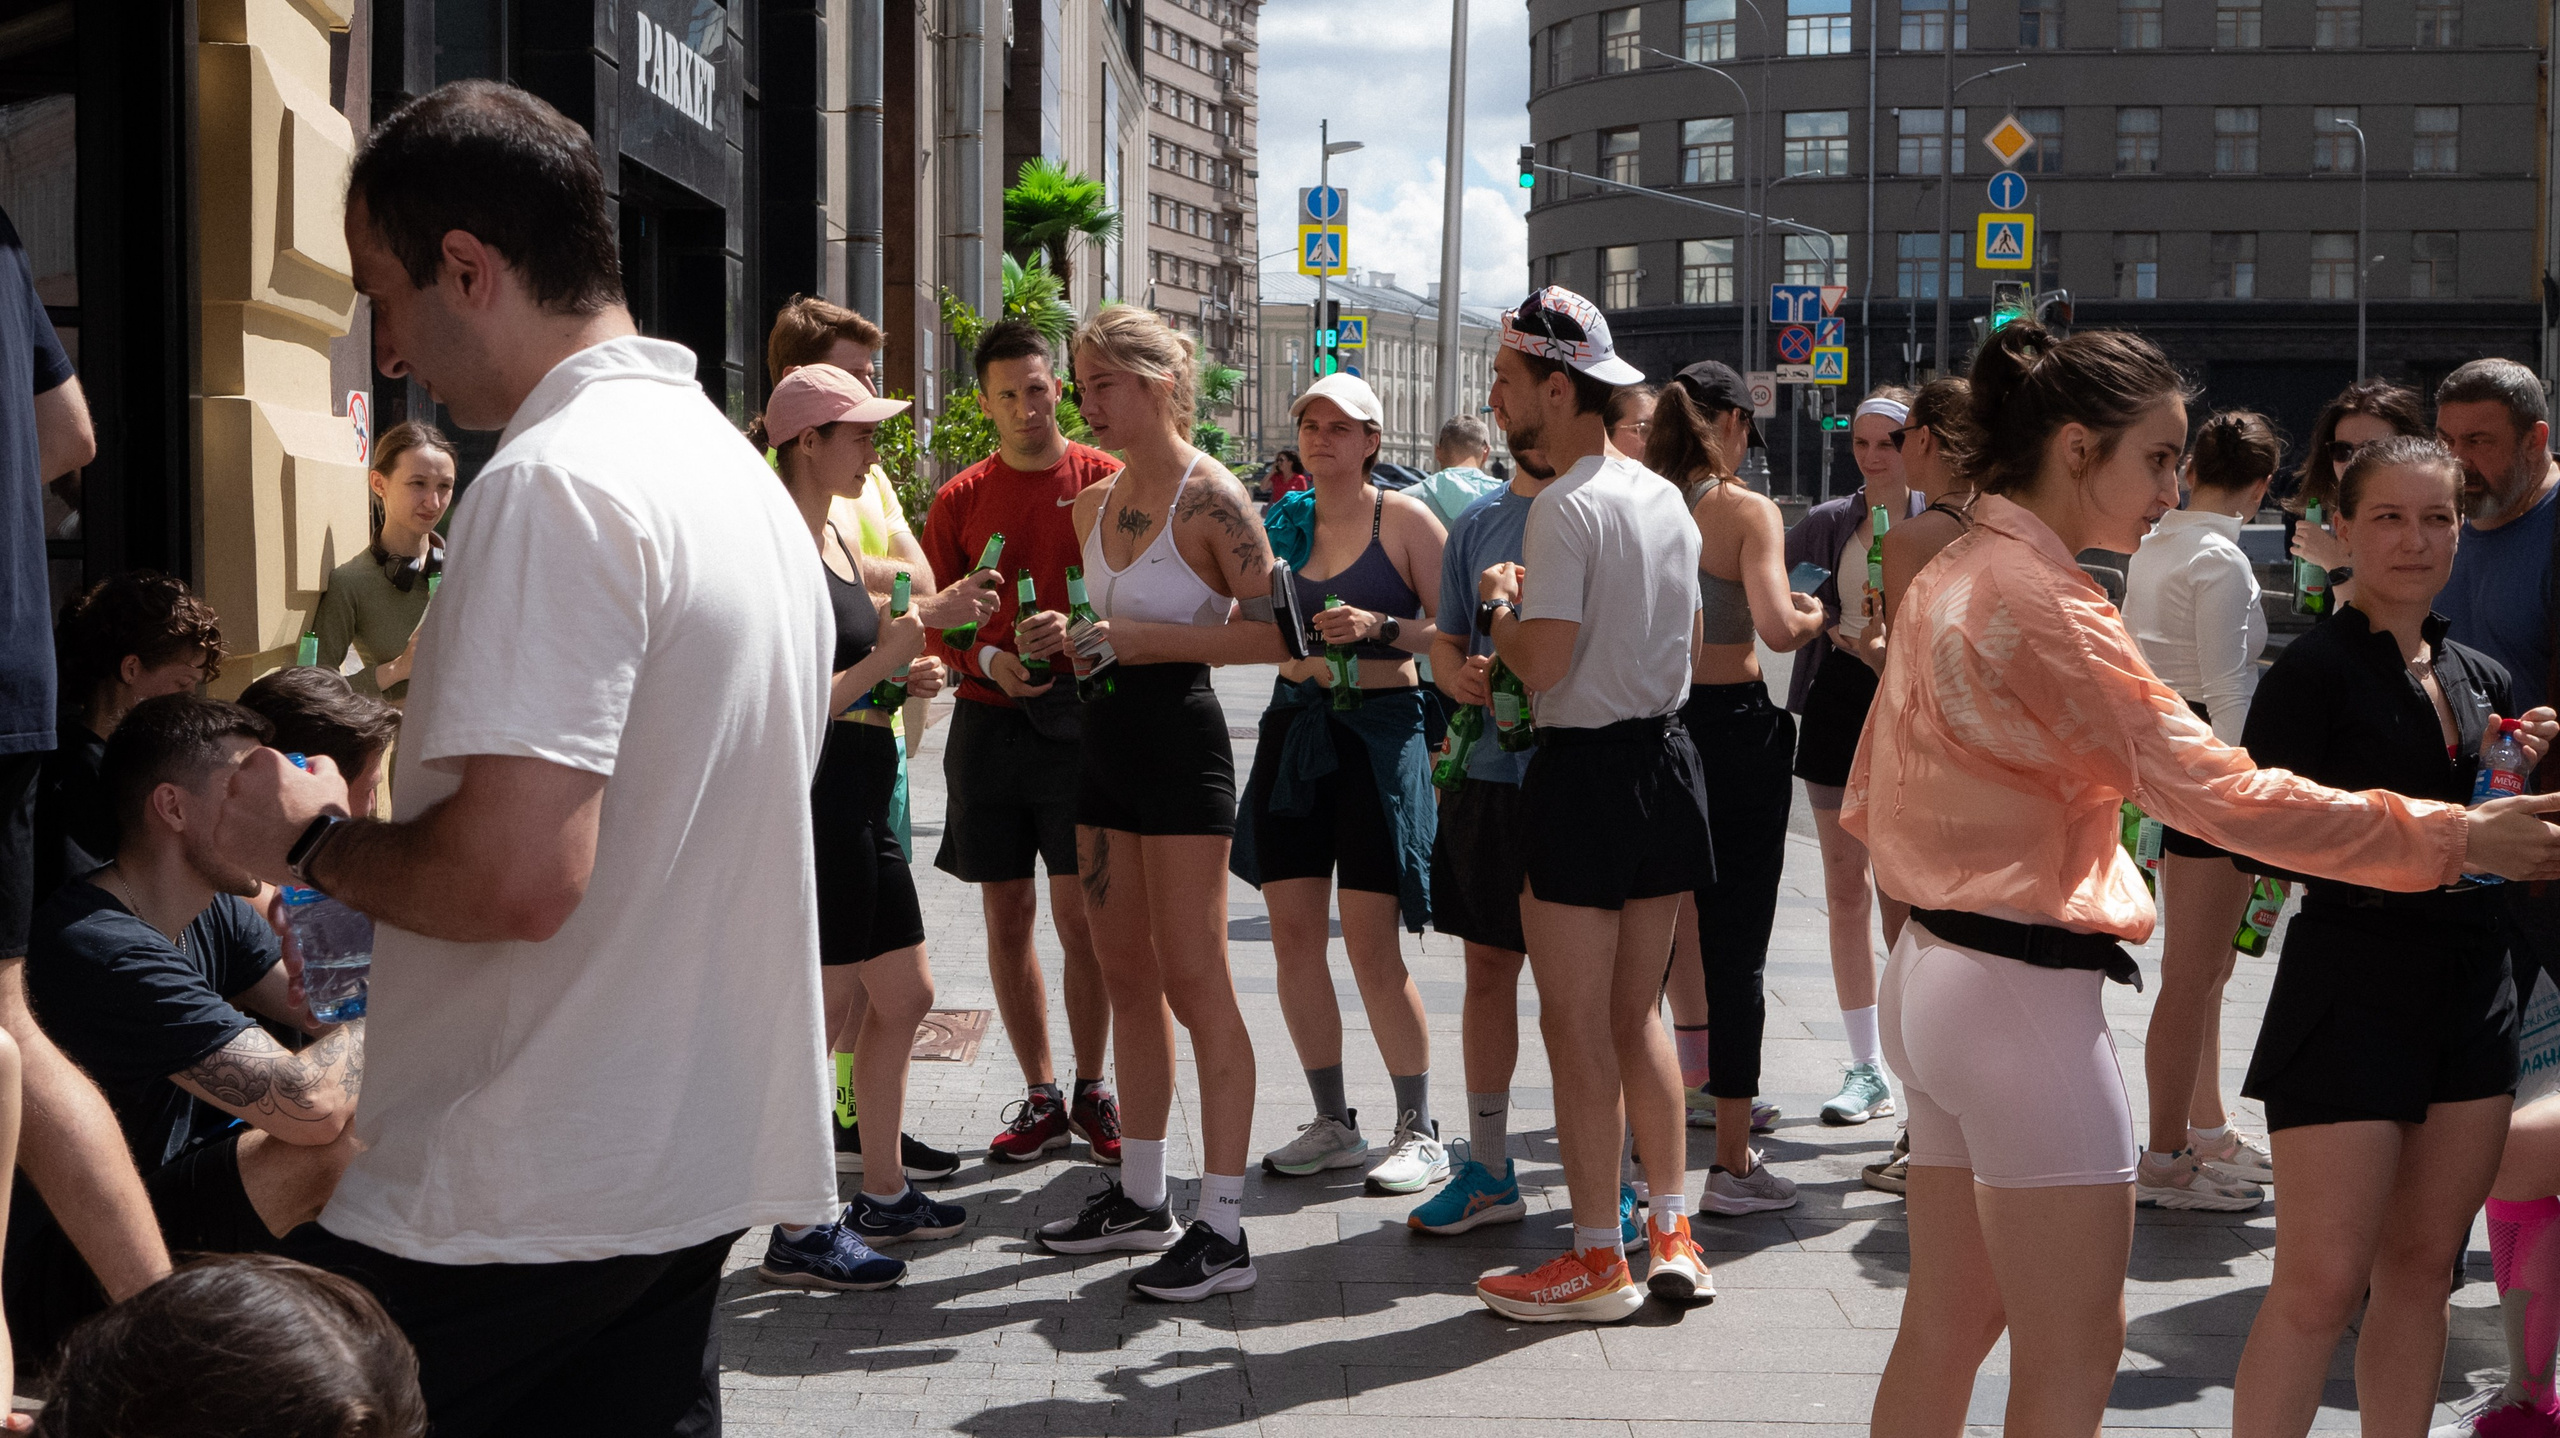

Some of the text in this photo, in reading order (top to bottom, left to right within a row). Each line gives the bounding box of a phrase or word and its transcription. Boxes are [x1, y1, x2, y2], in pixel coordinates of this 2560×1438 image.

[637, 10, 716, 131] PARKET
[1754, 391, 1767, 400] 50
[2493, 775, 2522, 791] MEVER
[1530, 1272, 1593, 1304] TERREX
